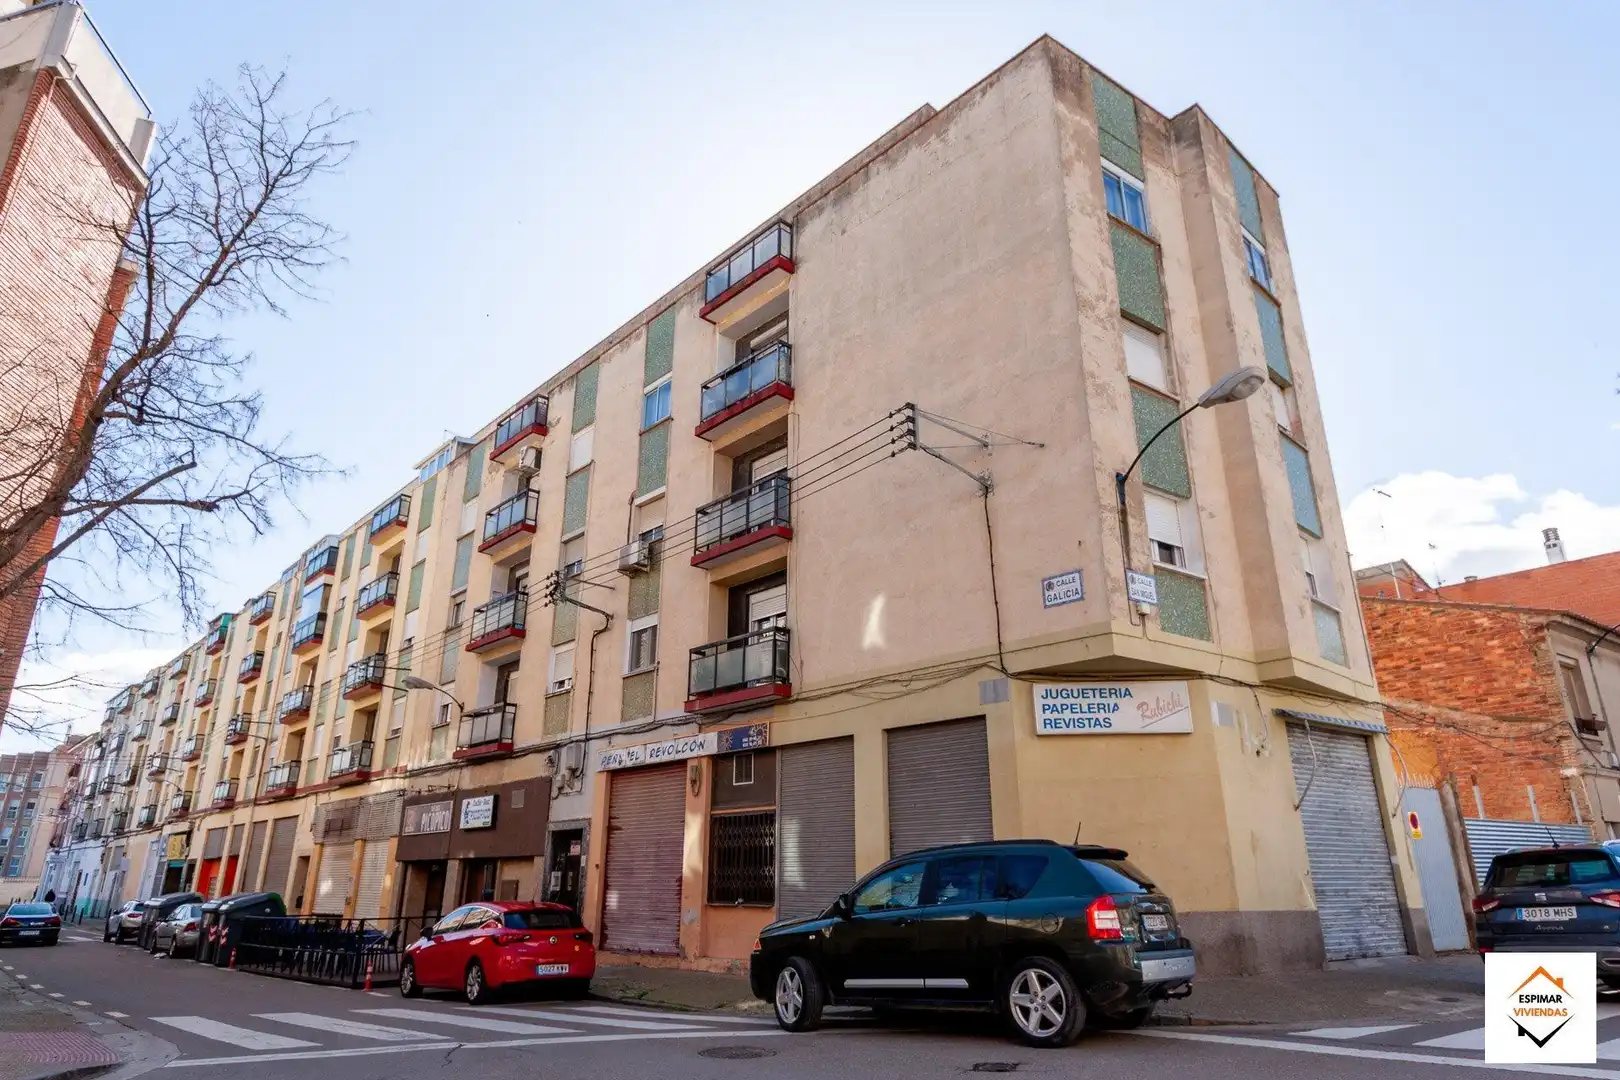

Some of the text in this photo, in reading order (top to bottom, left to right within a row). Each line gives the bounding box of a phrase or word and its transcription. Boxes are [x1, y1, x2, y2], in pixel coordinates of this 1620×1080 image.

[1055, 576, 1077, 587] CALLE
[1137, 577, 1153, 587] CALLE
[1046, 588, 1080, 602] GALICIA
[1041, 688, 1133, 699] JUGUETERIA
[1042, 702, 1120, 714] PAPELERIA
[1043, 717, 1113, 729] REVISTAS
[1525, 908, 1574, 918] 3018 MHS
